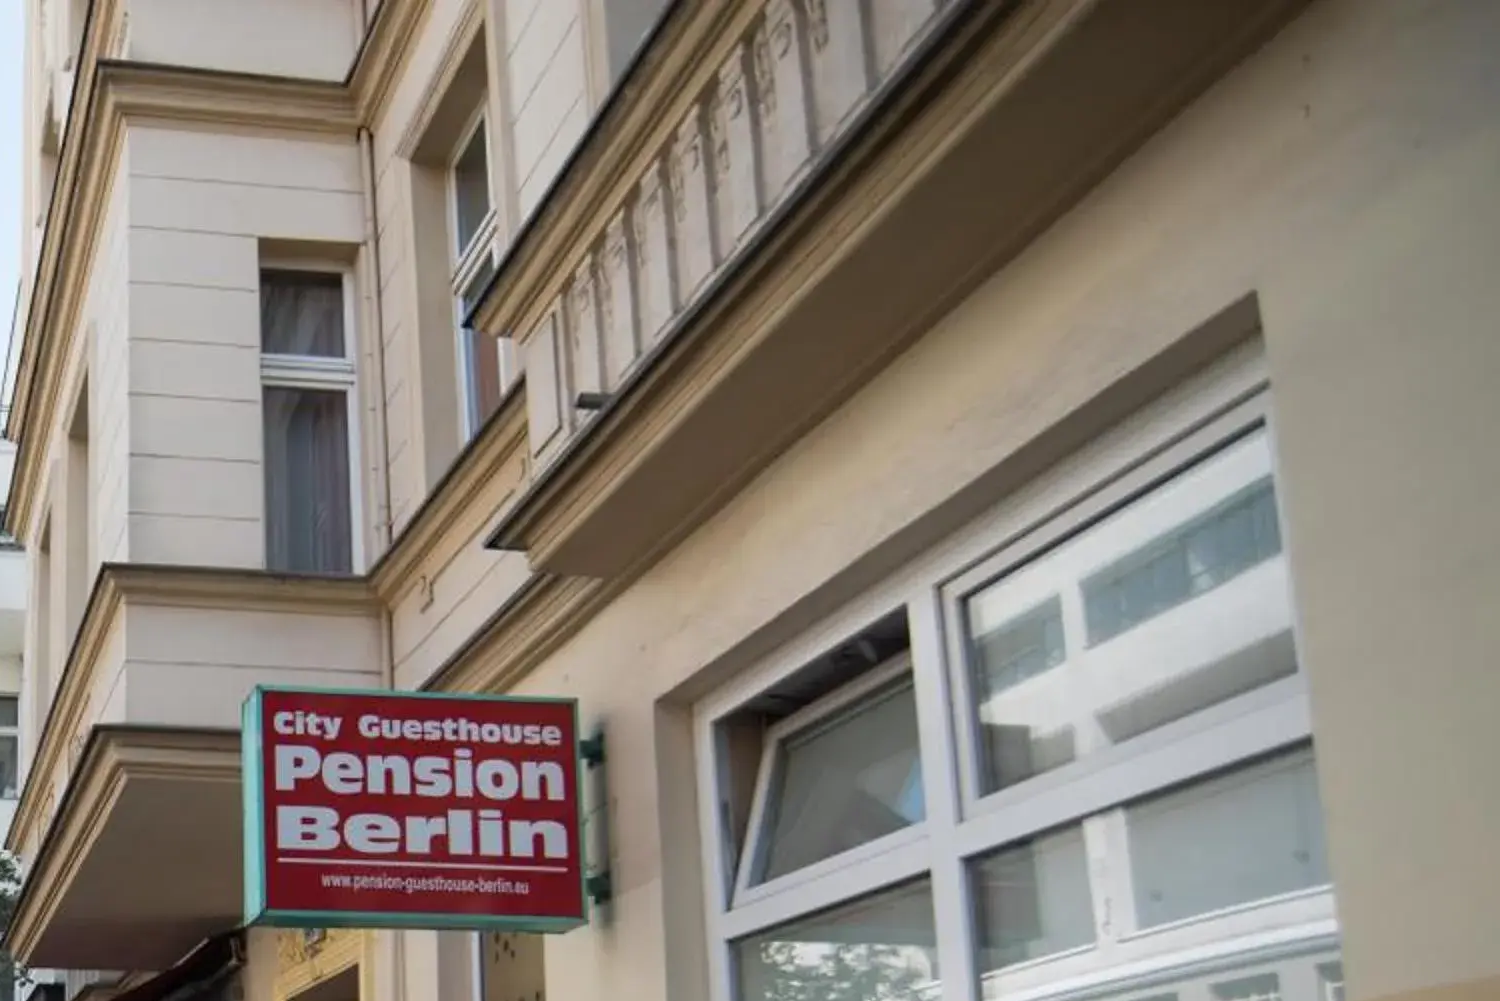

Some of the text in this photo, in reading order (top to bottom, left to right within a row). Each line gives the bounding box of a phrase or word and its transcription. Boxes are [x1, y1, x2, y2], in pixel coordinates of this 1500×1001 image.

[273, 710, 562, 746] City Guesthouse
[274, 743, 565, 801] Pension
[275, 805, 569, 859] Berlin
[320, 872, 530, 895] www.pension-guesthouse-berlin.eu
